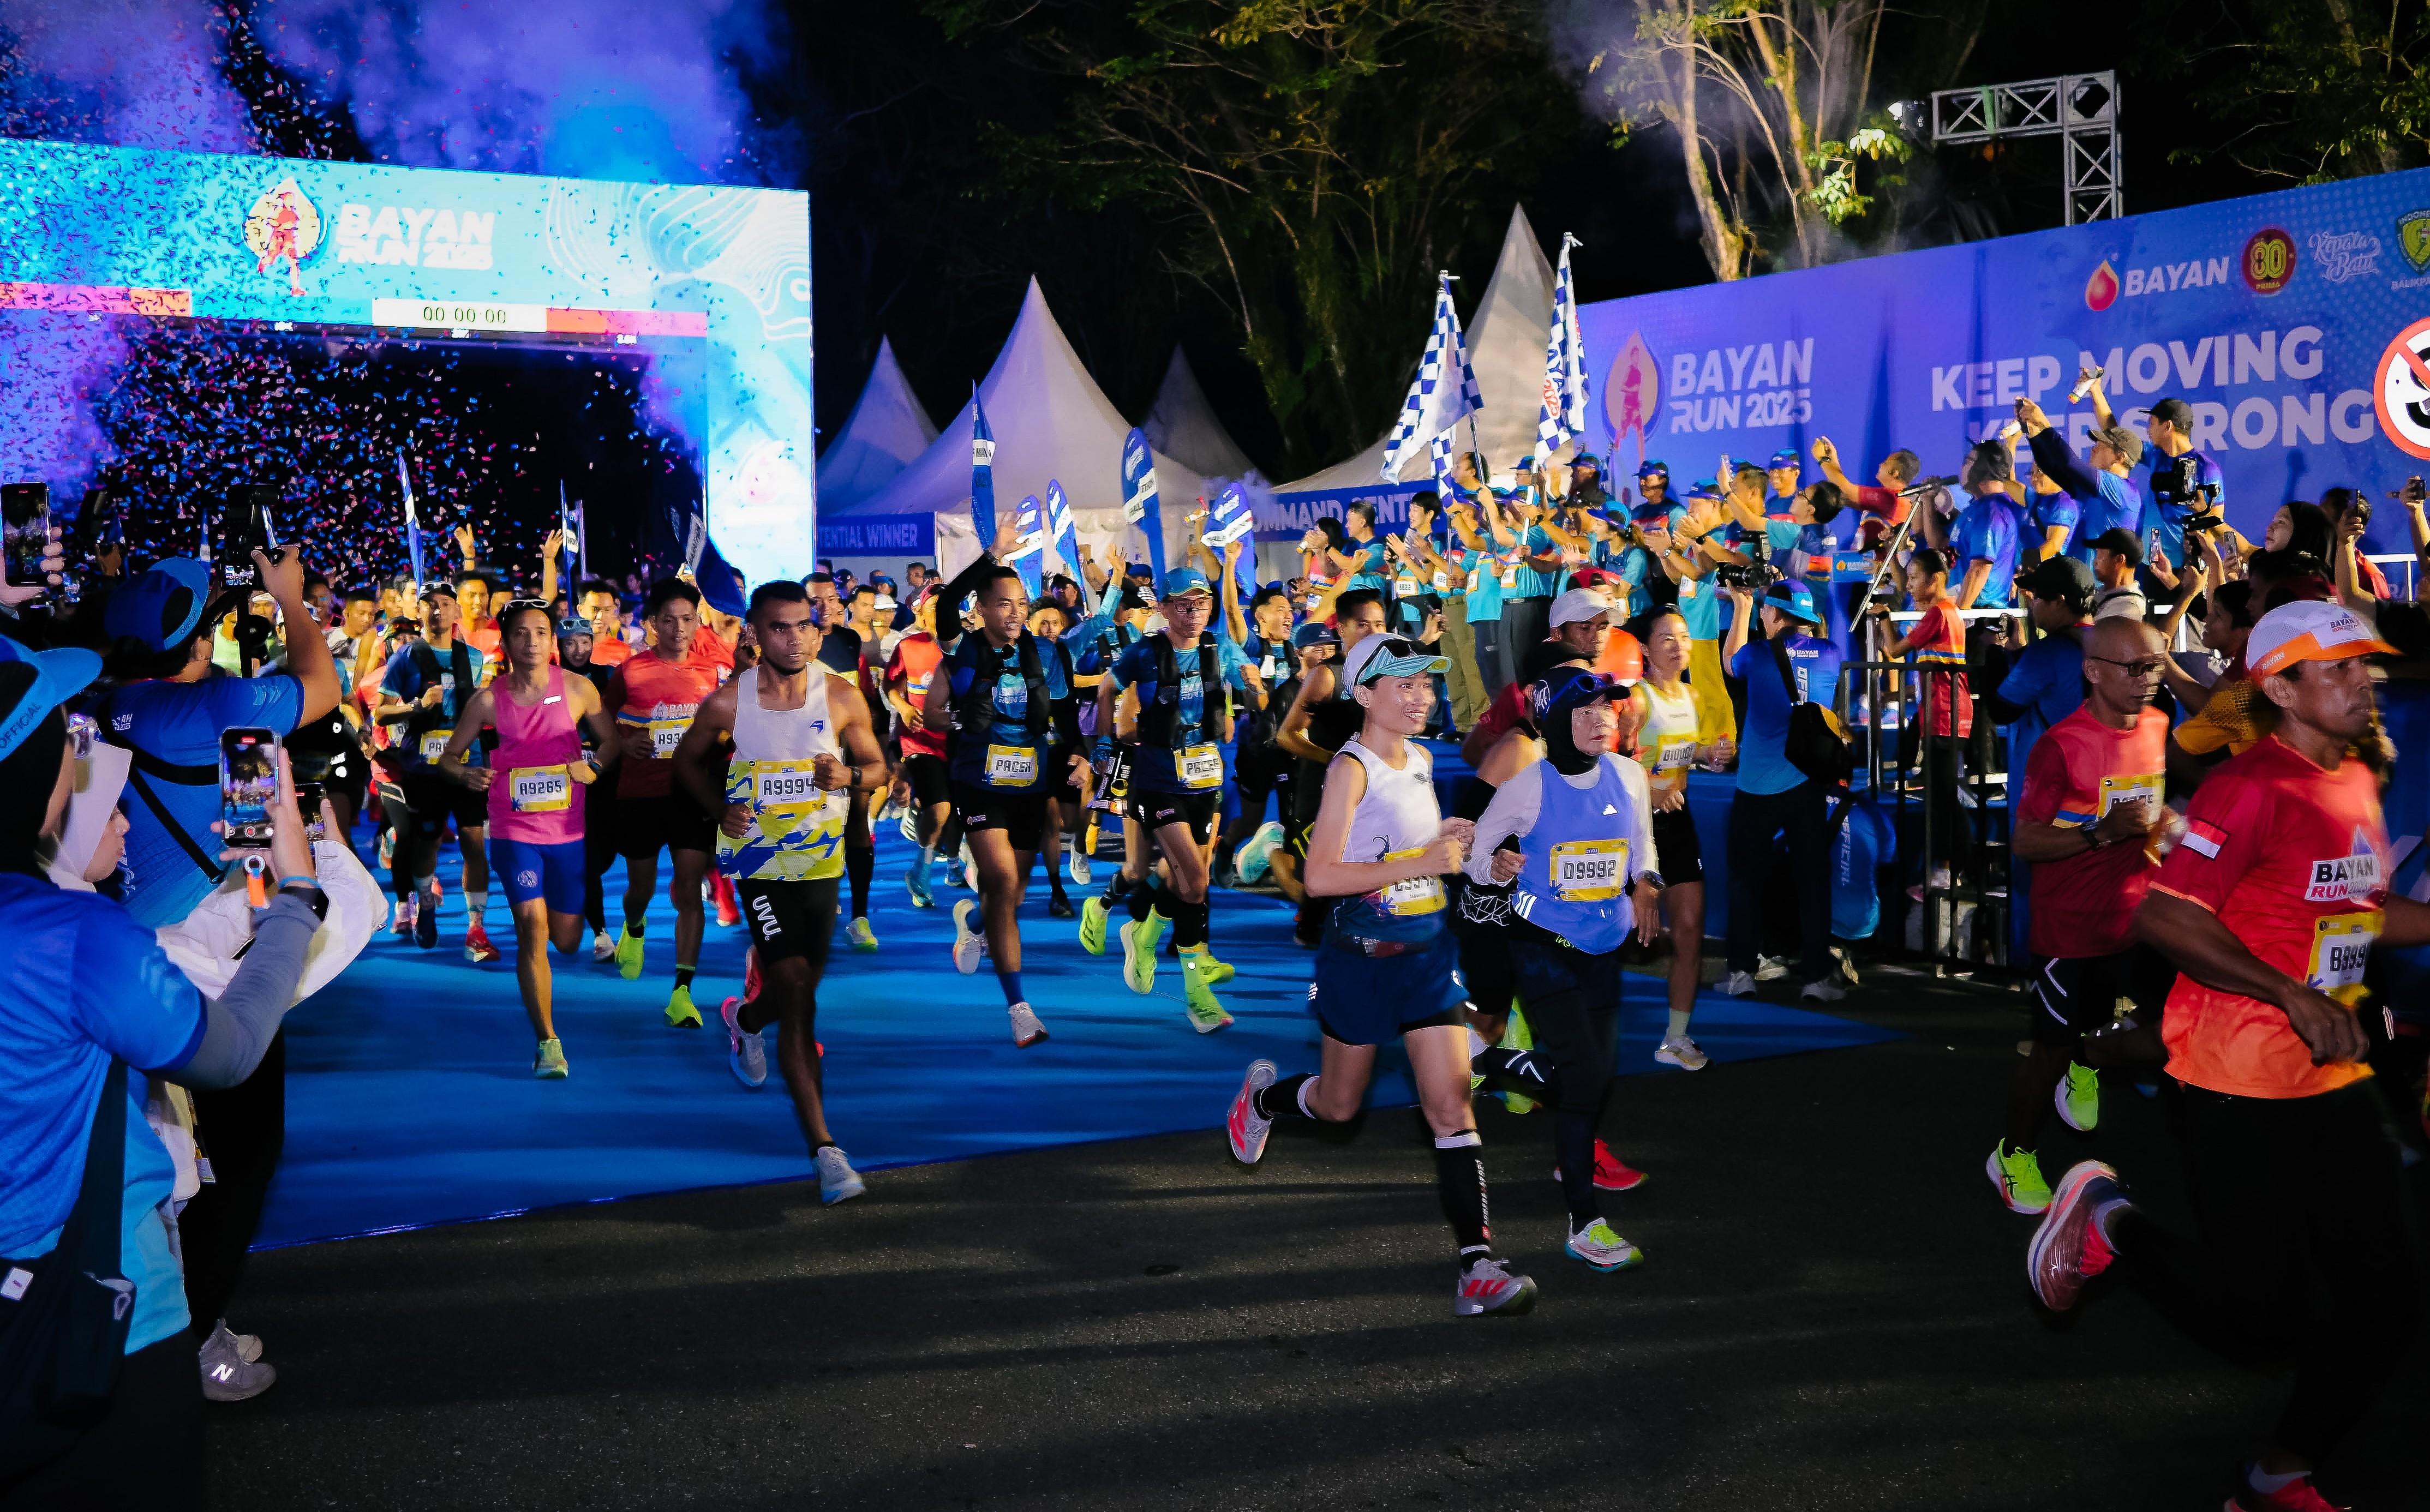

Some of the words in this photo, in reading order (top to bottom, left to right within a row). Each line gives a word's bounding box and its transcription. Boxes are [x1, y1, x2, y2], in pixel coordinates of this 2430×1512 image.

[336, 203, 495, 243] BAYAN
[337, 239, 418, 266] RUN
[2124, 261, 2230, 296] BAYAN
[1671, 338, 1815, 397] BAYAN
[1932, 355, 2062, 411] KEEP
[2079, 326, 2323, 397] MOVING
[1667, 394, 1741, 434] RUN
[1746, 388, 1813, 428] 2025
[2120, 388, 2374, 461] SRONG
[818, 524, 864, 548] TENTIAL
[866, 523, 918, 548] WINNER
[2330, 617, 2355, 628] BAYAN
[2262, 651, 2285, 670] BAYAN
[658, 733, 680, 745] A93
[519, 779, 562, 795] A9265
[764, 777, 816, 796] A9994
[1563, 859, 1617, 879] D9992
[2315, 857, 2374, 884] BAYAN
[2311, 884, 2349, 898] RUN
[753, 895, 781, 935] UVU
[2330, 942, 2371, 973] B999
[211, 1363, 234, 1381] N
